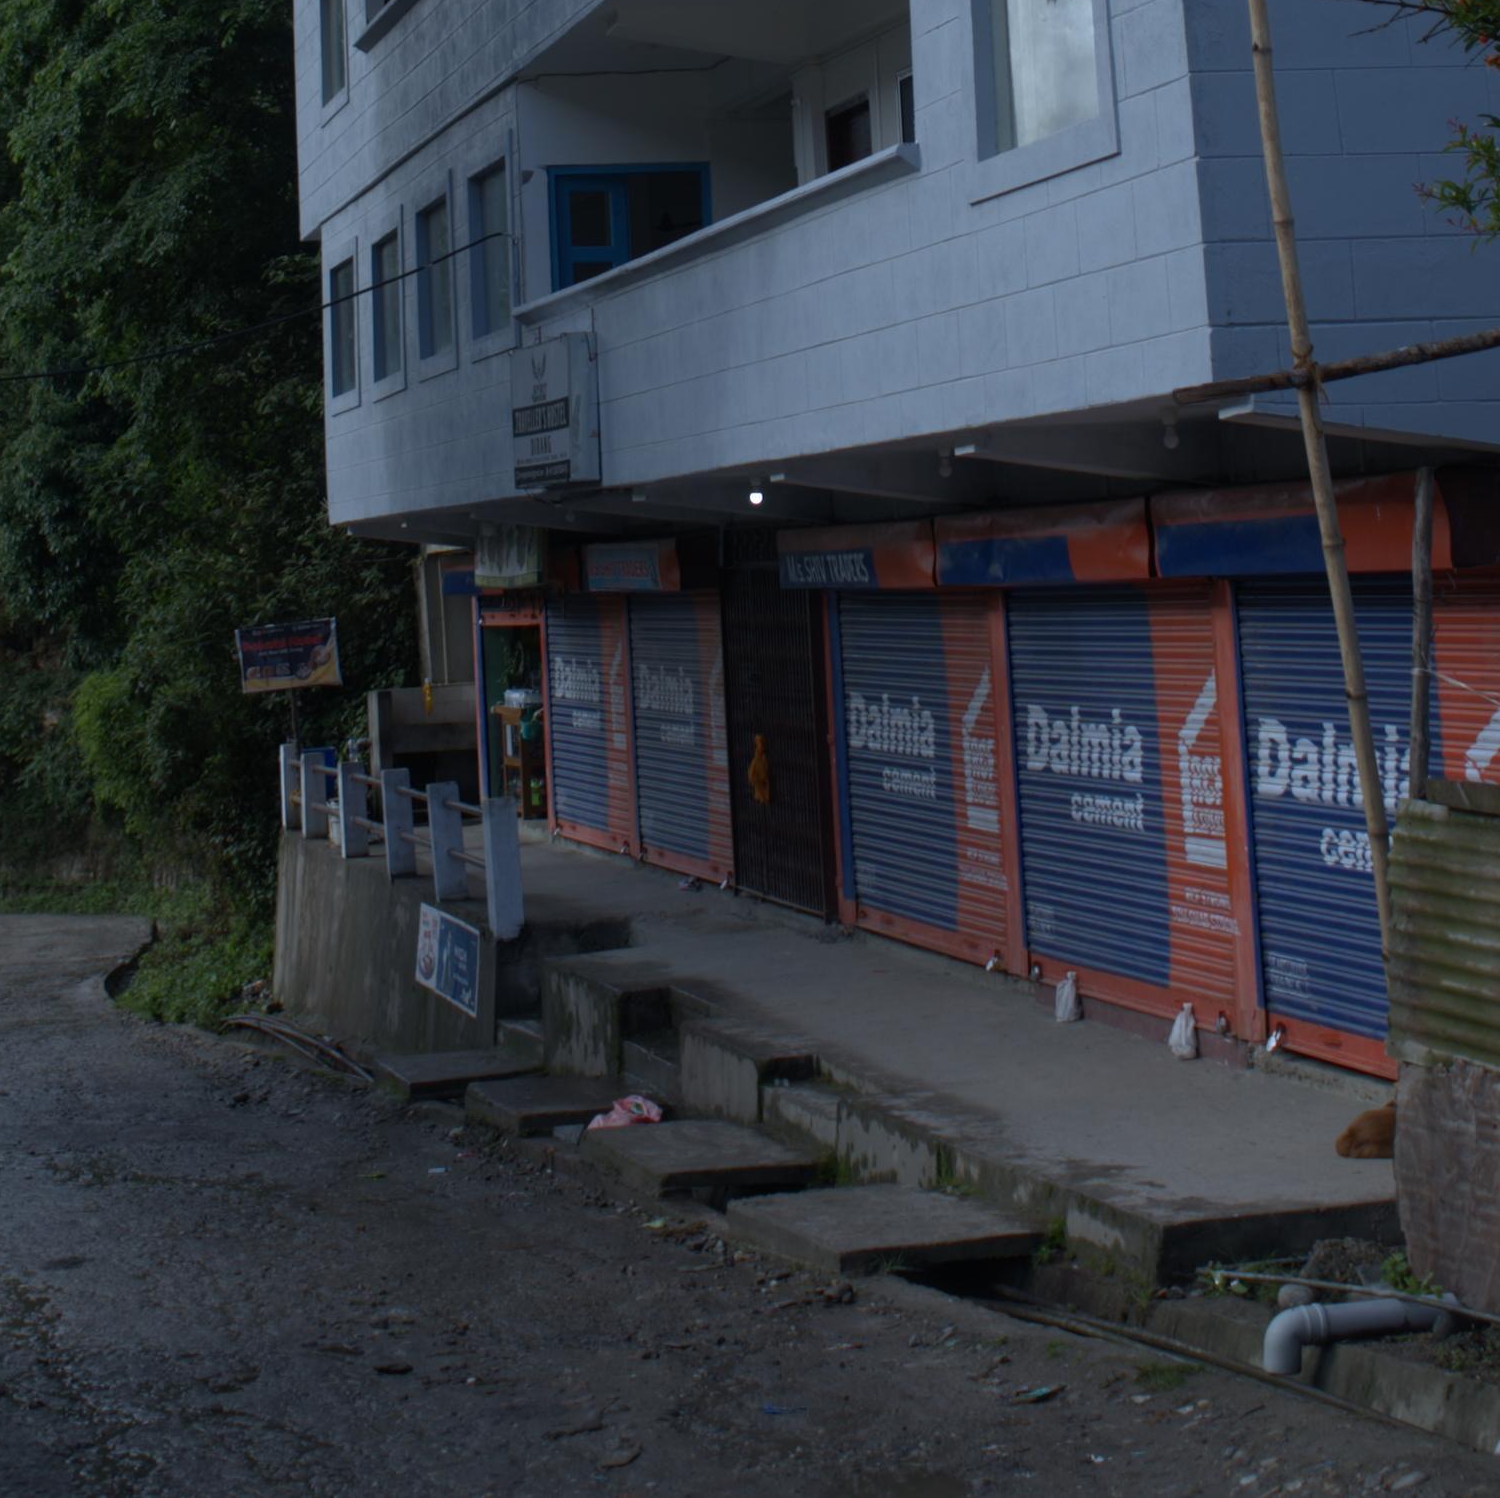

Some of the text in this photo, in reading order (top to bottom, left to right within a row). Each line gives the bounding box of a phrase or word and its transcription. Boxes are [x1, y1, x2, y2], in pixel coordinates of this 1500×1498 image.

[826, 552, 870, 583] TRADERS
[554, 656, 600, 702] Dalmia
[639, 663, 694, 715] Dalmia
[847, 690, 935, 759] Dalmia
[1026, 704, 1143, 783] Dalmia
[882, 766, 936, 799] cement
[1256, 717, 1411, 814] Dalmi
[1071, 792, 1145, 833] cement
